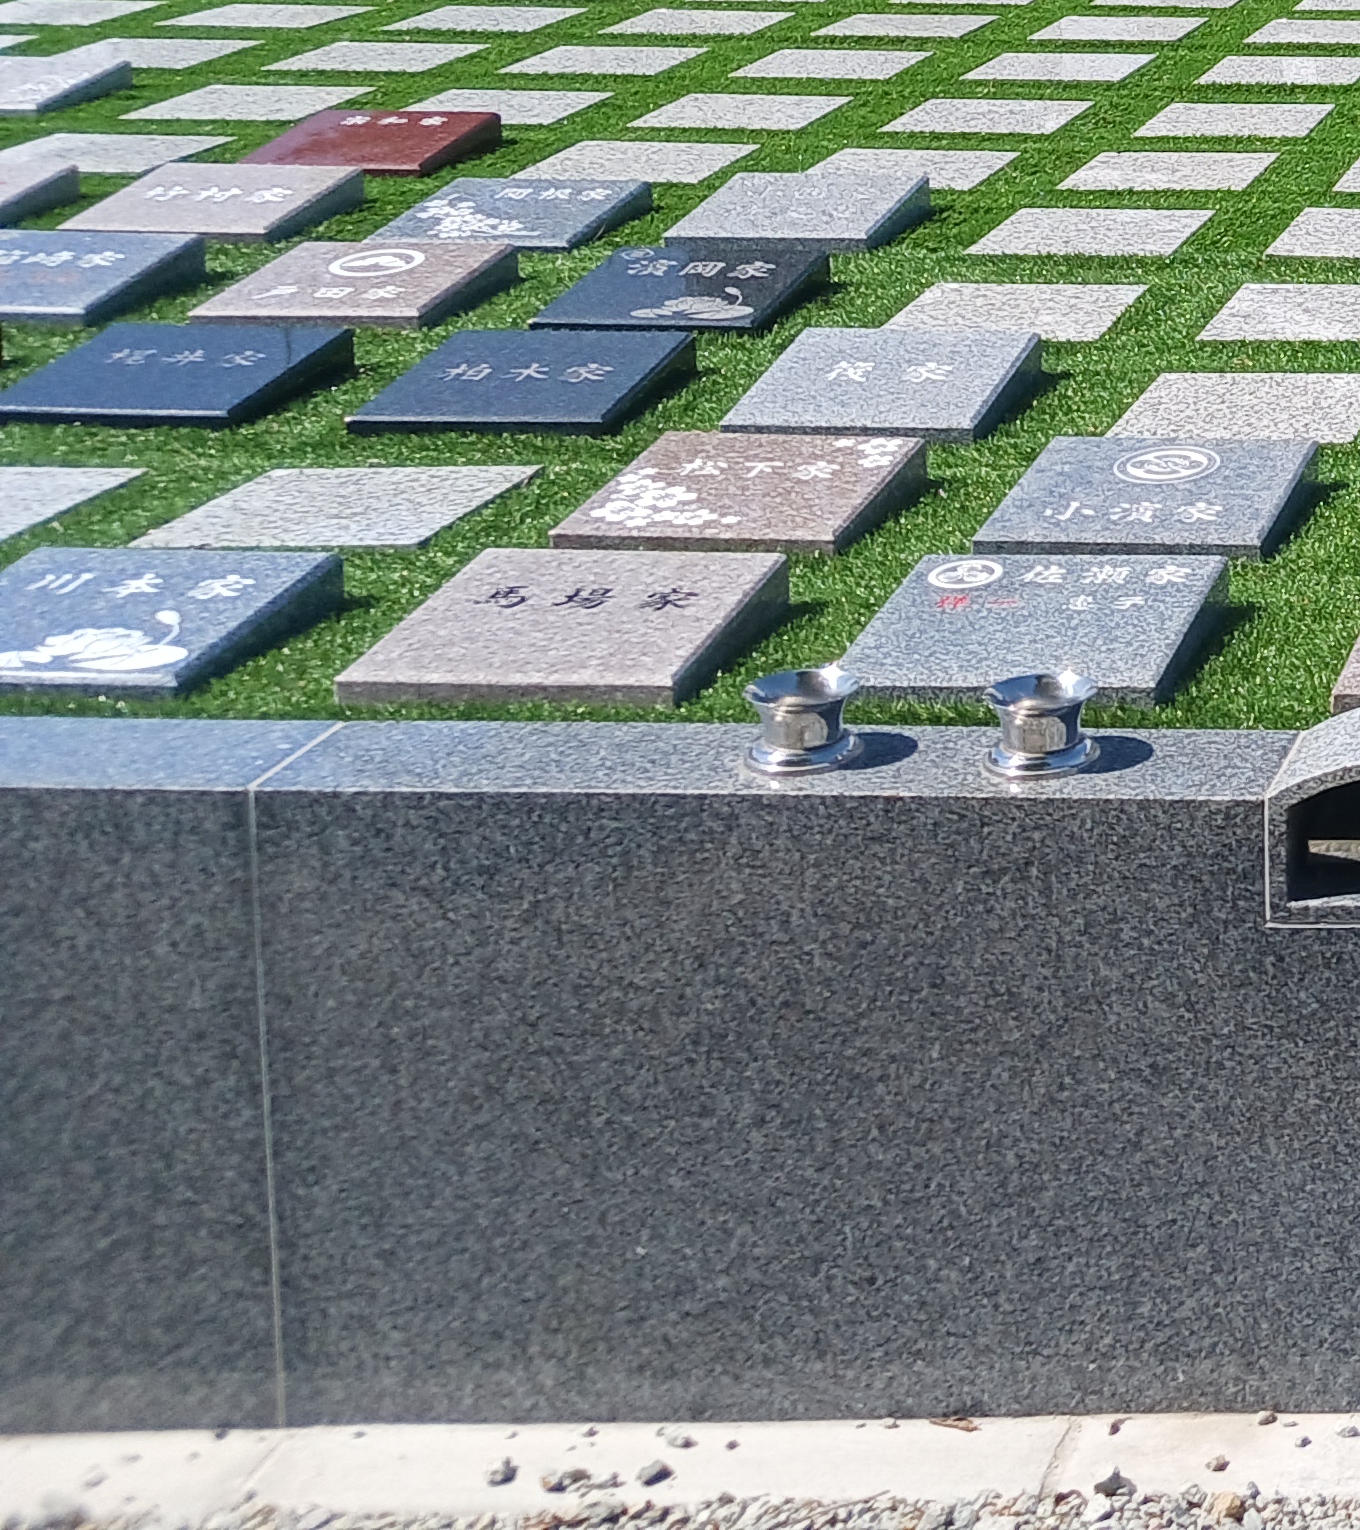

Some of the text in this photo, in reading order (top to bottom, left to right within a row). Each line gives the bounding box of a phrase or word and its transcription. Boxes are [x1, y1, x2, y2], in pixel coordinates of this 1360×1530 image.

[679, 459, 843, 481] 松下家
[472, 585, 701, 610] 馬場家
